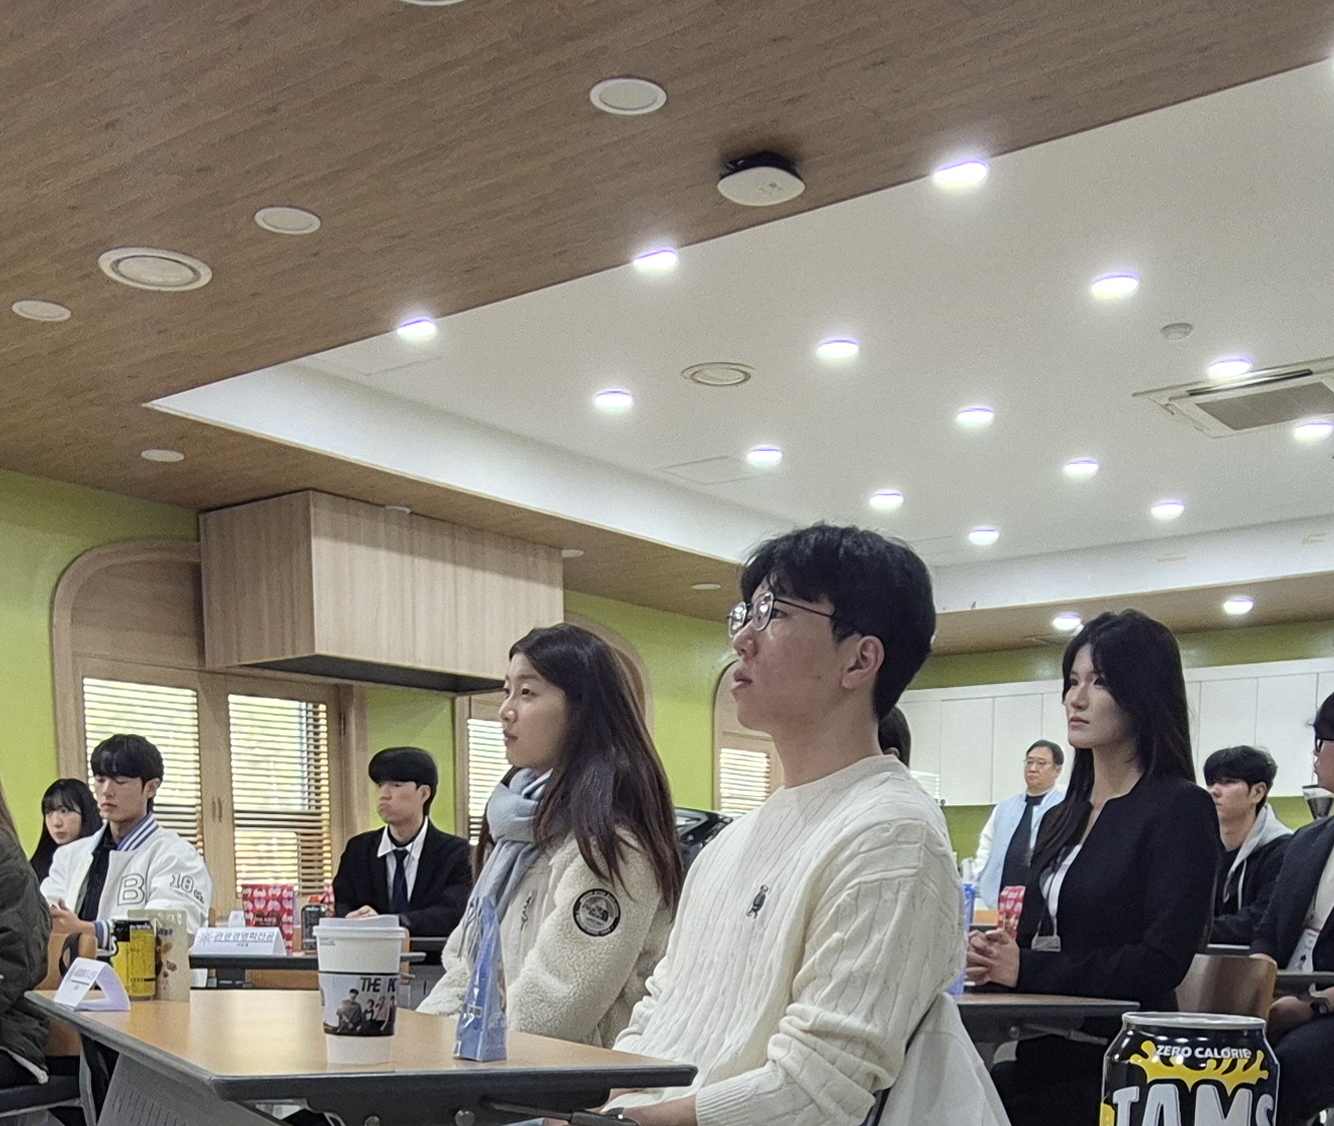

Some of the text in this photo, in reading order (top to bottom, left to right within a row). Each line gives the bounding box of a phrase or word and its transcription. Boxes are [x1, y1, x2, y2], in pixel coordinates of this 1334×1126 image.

[117, 873, 145, 906] B
[1156, 1045, 1252, 1059] ZERO CALORIE
